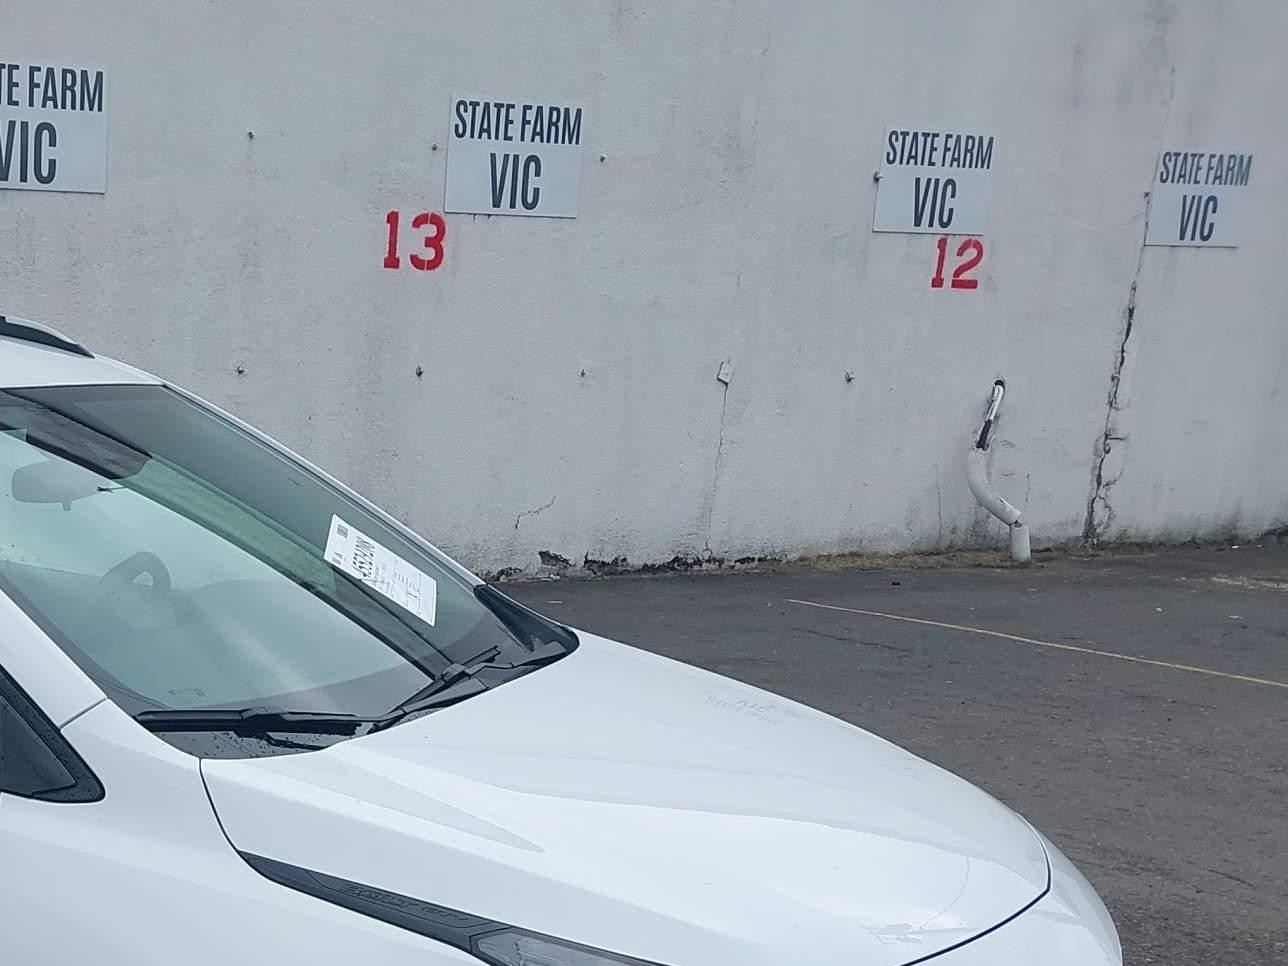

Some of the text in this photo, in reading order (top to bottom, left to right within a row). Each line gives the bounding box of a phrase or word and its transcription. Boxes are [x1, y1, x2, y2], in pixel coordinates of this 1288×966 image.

[28, 65, 104, 112] FARM
[454, 99, 583, 146] STATE FARM
[885, 129, 994, 170] STATE FARM
[1159, 151, 1253, 187] STATE FARM
[489, 152, 542, 211] VIC
[913, 176, 957, 229] VIC
[383, 210, 446, 271] 13
[1179, 194, 1218, 242] VIC
[930, 234, 985, 289] 12
